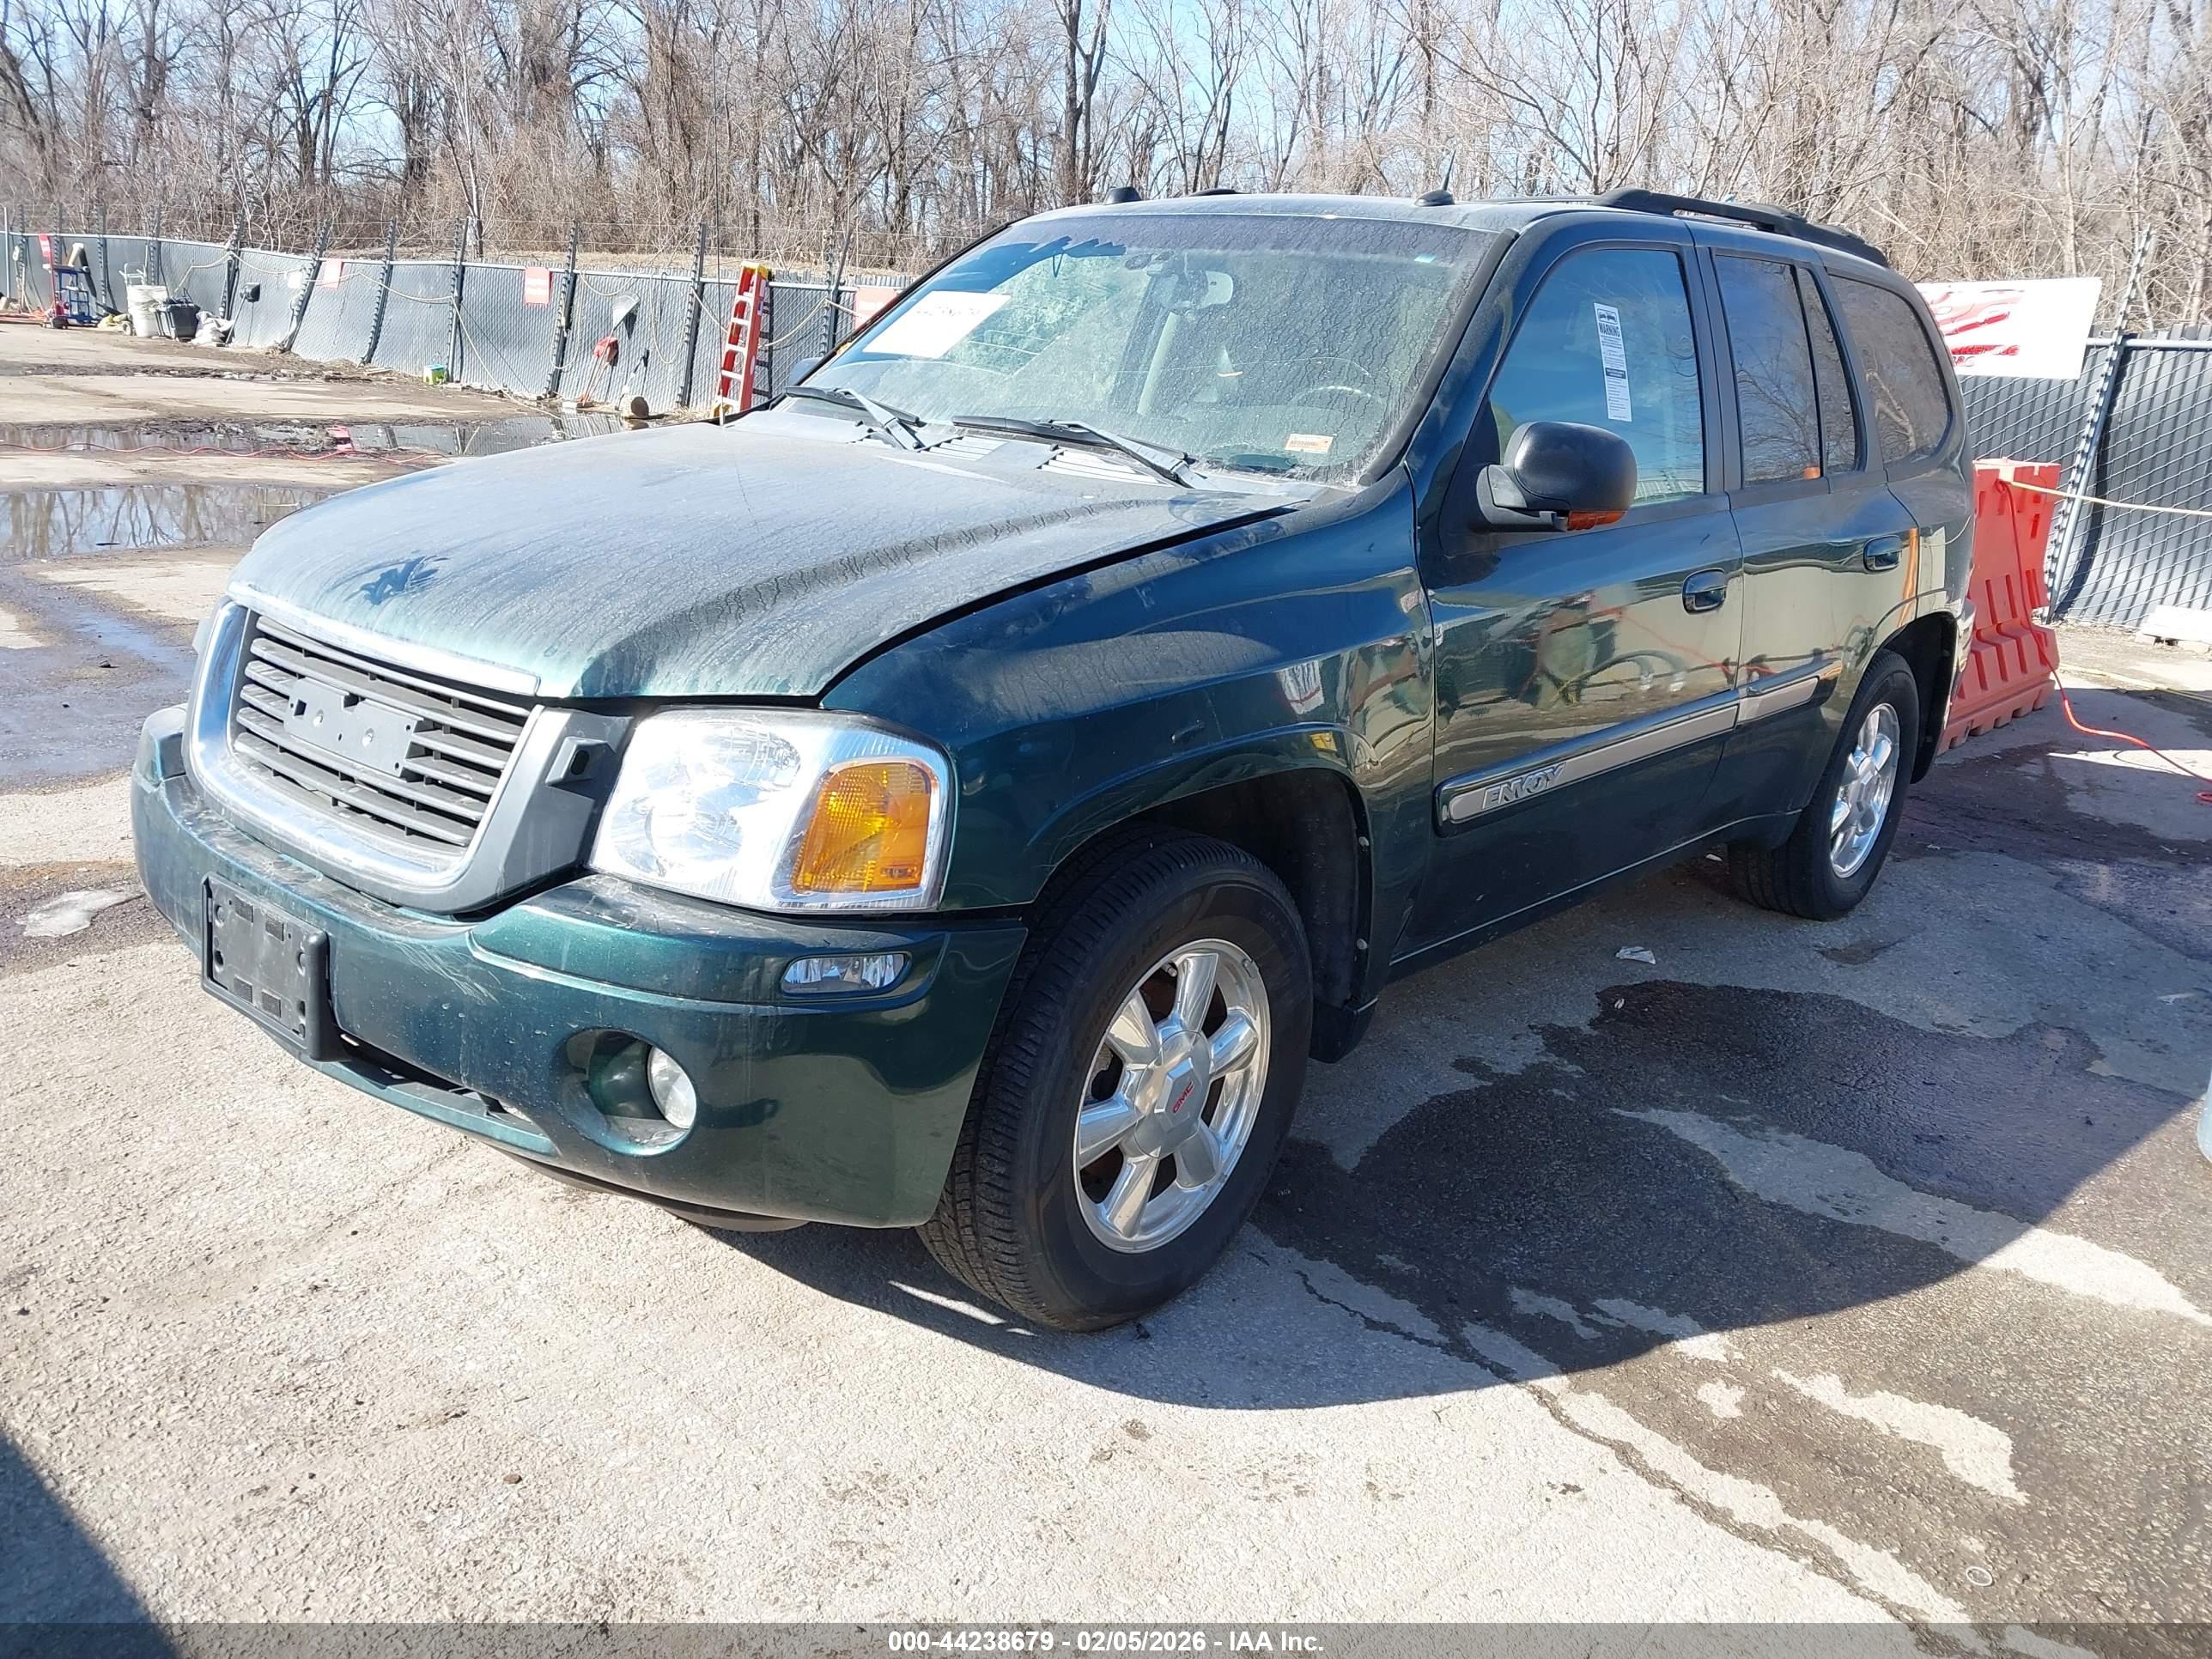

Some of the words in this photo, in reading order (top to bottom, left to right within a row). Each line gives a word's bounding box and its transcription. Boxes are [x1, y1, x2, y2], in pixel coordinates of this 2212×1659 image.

[1598, 323, 1620, 337] WARNING
[1482, 762, 1567, 810] ENVOY
[1172, 1080, 1194, 1114] GMC
